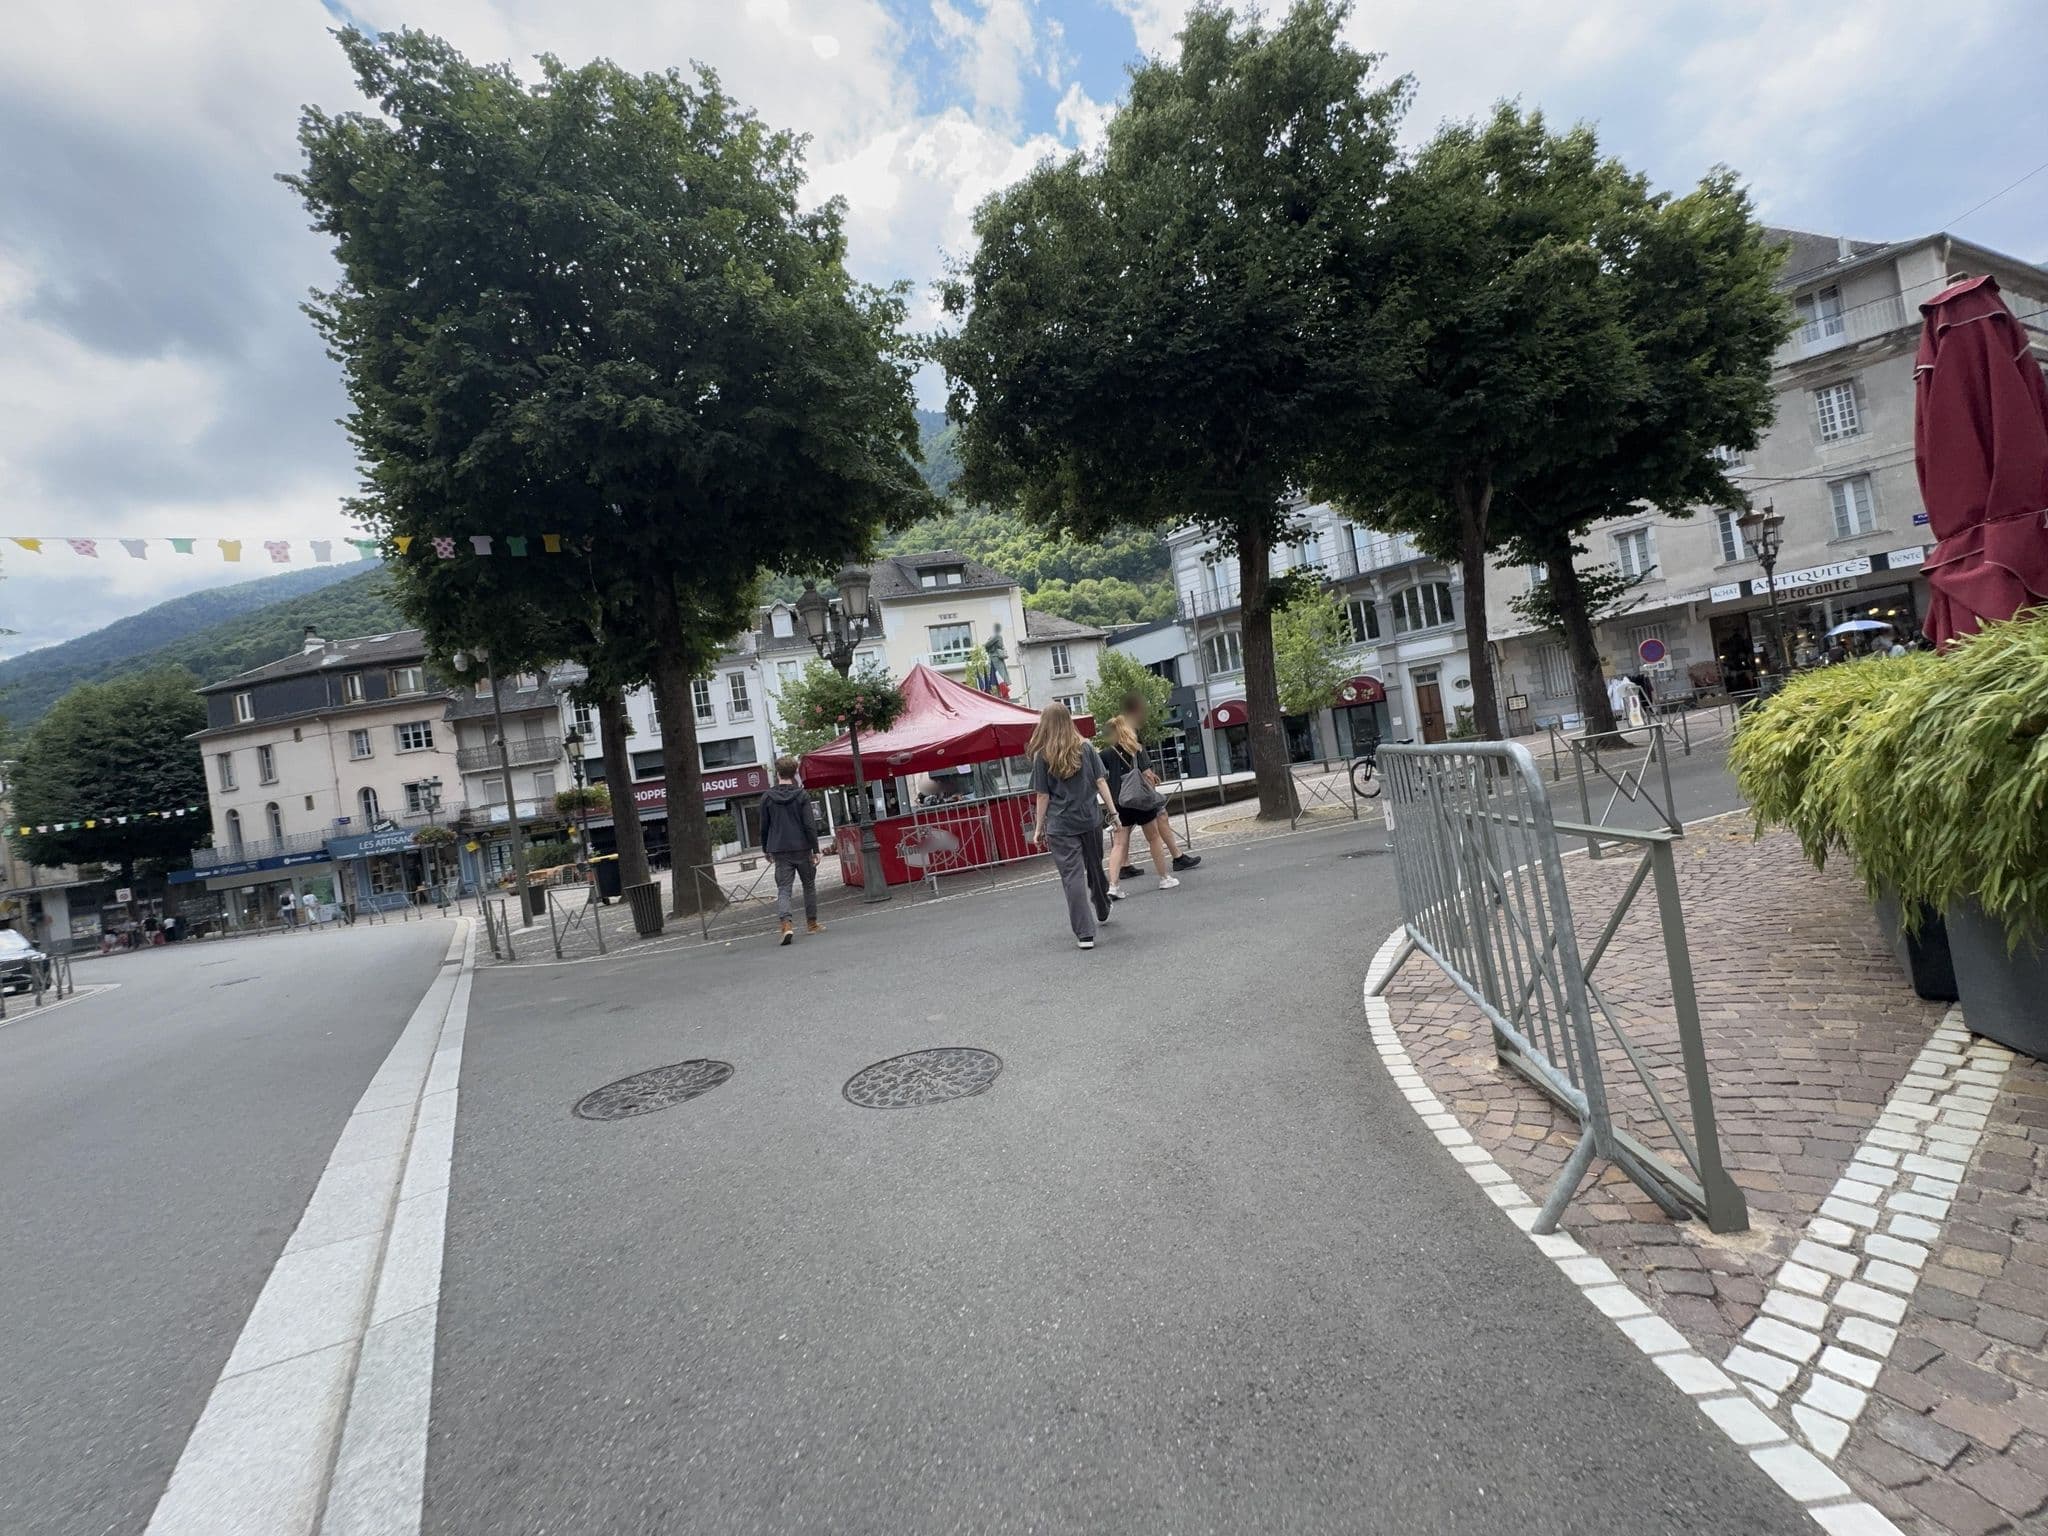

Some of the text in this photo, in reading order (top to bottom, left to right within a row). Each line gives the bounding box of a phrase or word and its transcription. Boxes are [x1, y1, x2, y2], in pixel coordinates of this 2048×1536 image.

[1891, 552, 1921, 563] VENTE
[1753, 560, 1869, 590] ANTIQUITÉS
[1713, 587, 1738, 598] ACHAT
[633, 787, 667, 801] HOPPE
[359, 840, 374, 850] LES
[375, 834, 411, 847] ARTISAN
